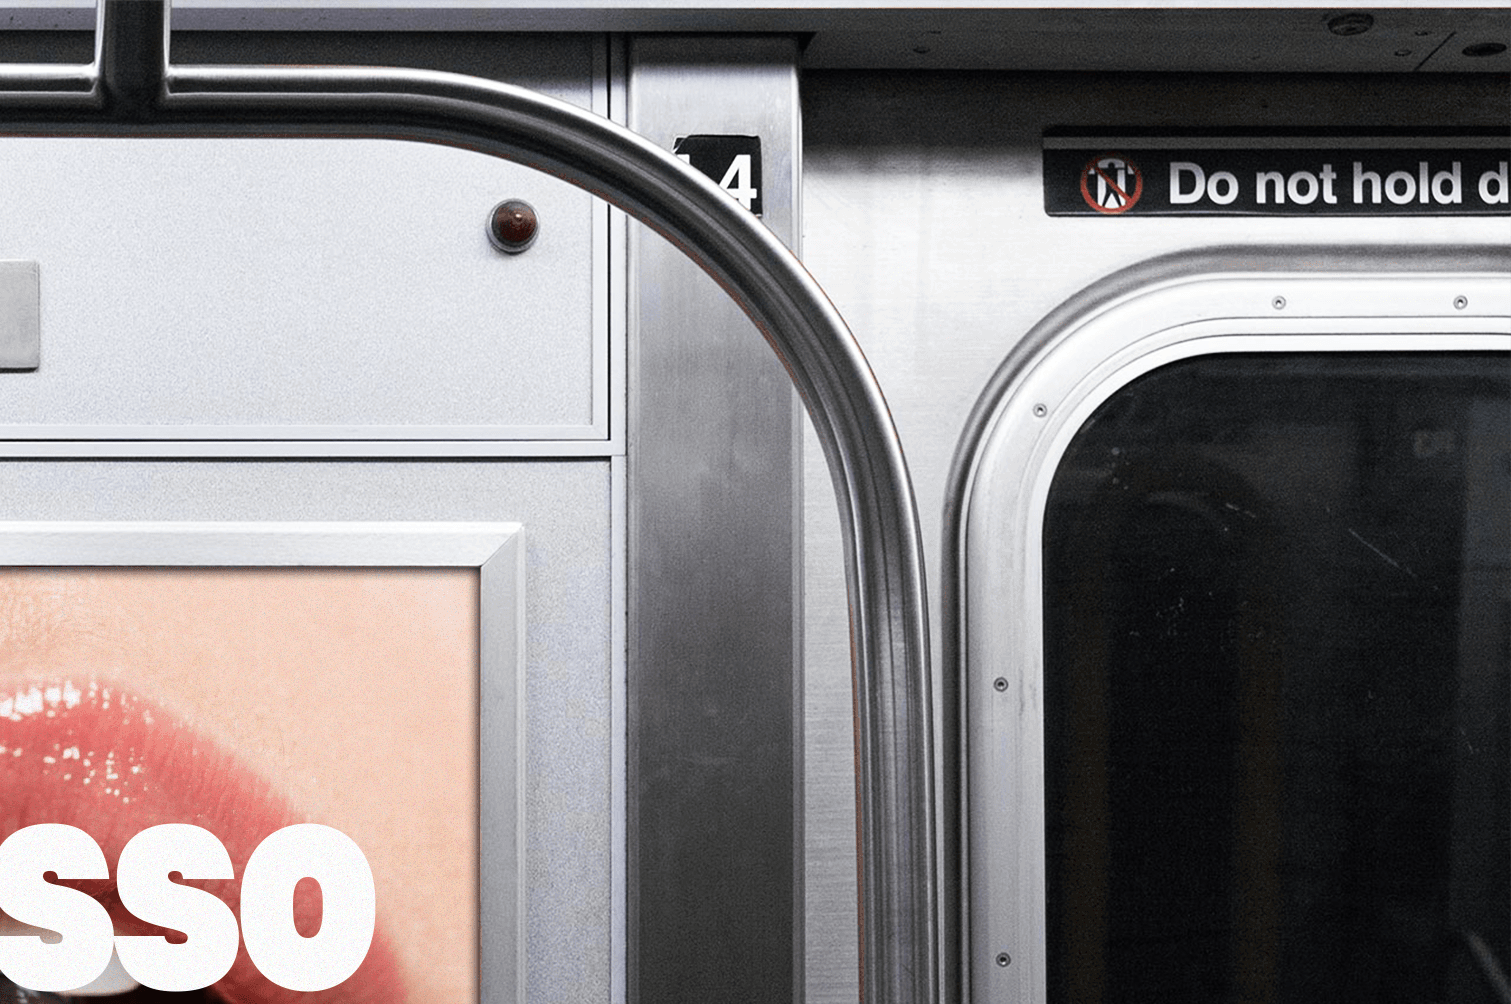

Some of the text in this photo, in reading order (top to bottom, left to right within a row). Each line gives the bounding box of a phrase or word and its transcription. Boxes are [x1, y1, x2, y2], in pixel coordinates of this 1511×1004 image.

[1169, 161, 1509, 205] Do not hold d
